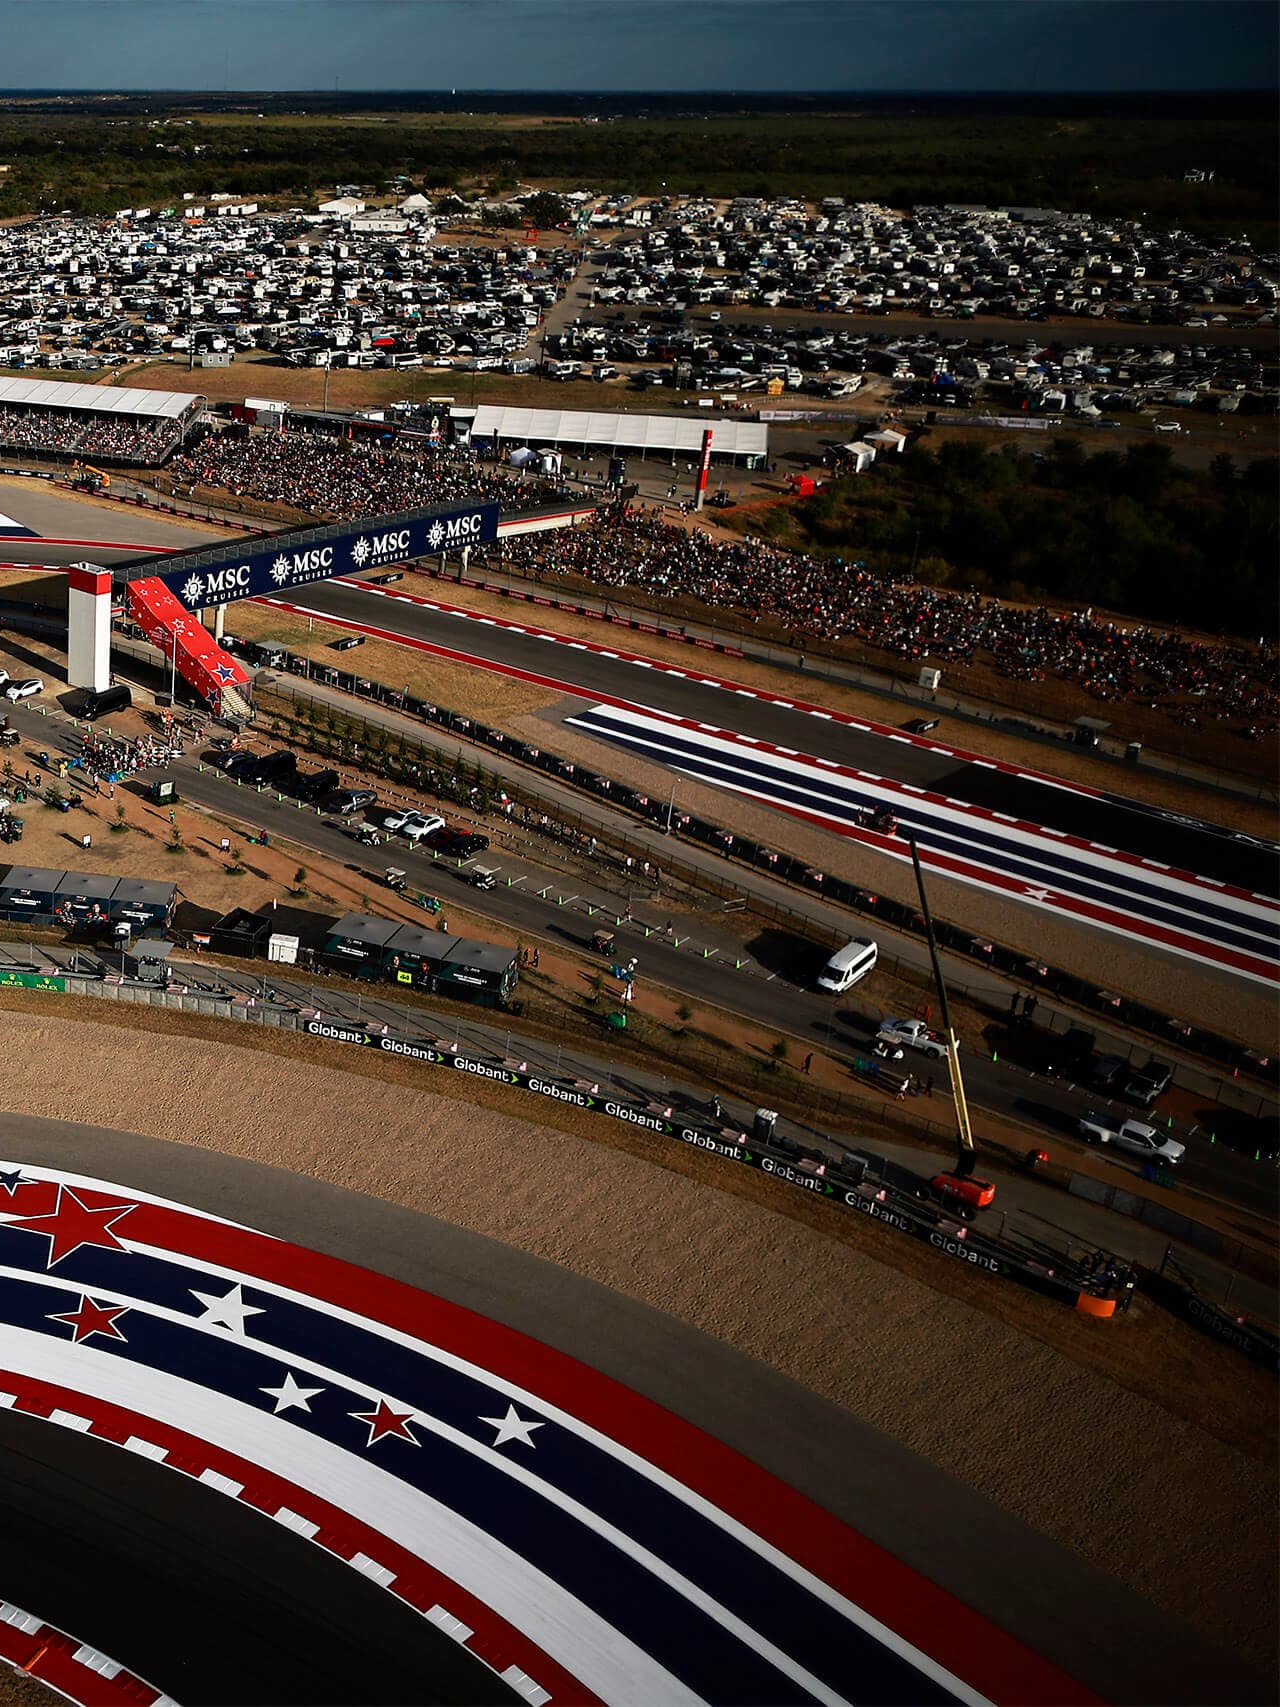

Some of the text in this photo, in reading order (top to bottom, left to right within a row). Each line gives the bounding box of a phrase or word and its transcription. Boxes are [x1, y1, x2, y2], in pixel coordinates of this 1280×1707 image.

[445, 514, 482, 539] MSC
[371, 530, 410, 556] MSC
[444, 534, 480, 548] CRUISES
[292, 547, 333, 574] MSC
[371, 550, 409, 565] CRUISES
[206, 565, 251, 593] MSC
[292, 568, 333, 584] CRUISES
[206, 587, 250, 604] CRUISES
[36, 983, 58, 992] ROLEX
[308, 1022, 363, 1045] Globant
[380, 1038, 435, 1062] Globant
[453, 1057, 509, 1083] Globant
[528, 1078, 585, 1106] Globant
[605, 1102, 663, 1132] Globant
[681, 1128, 742, 1160] Globant
[761, 1157, 822, 1193] Globant
[844, 1191, 909, 1231] Globant
[929, 1231, 999, 1272] Globant
